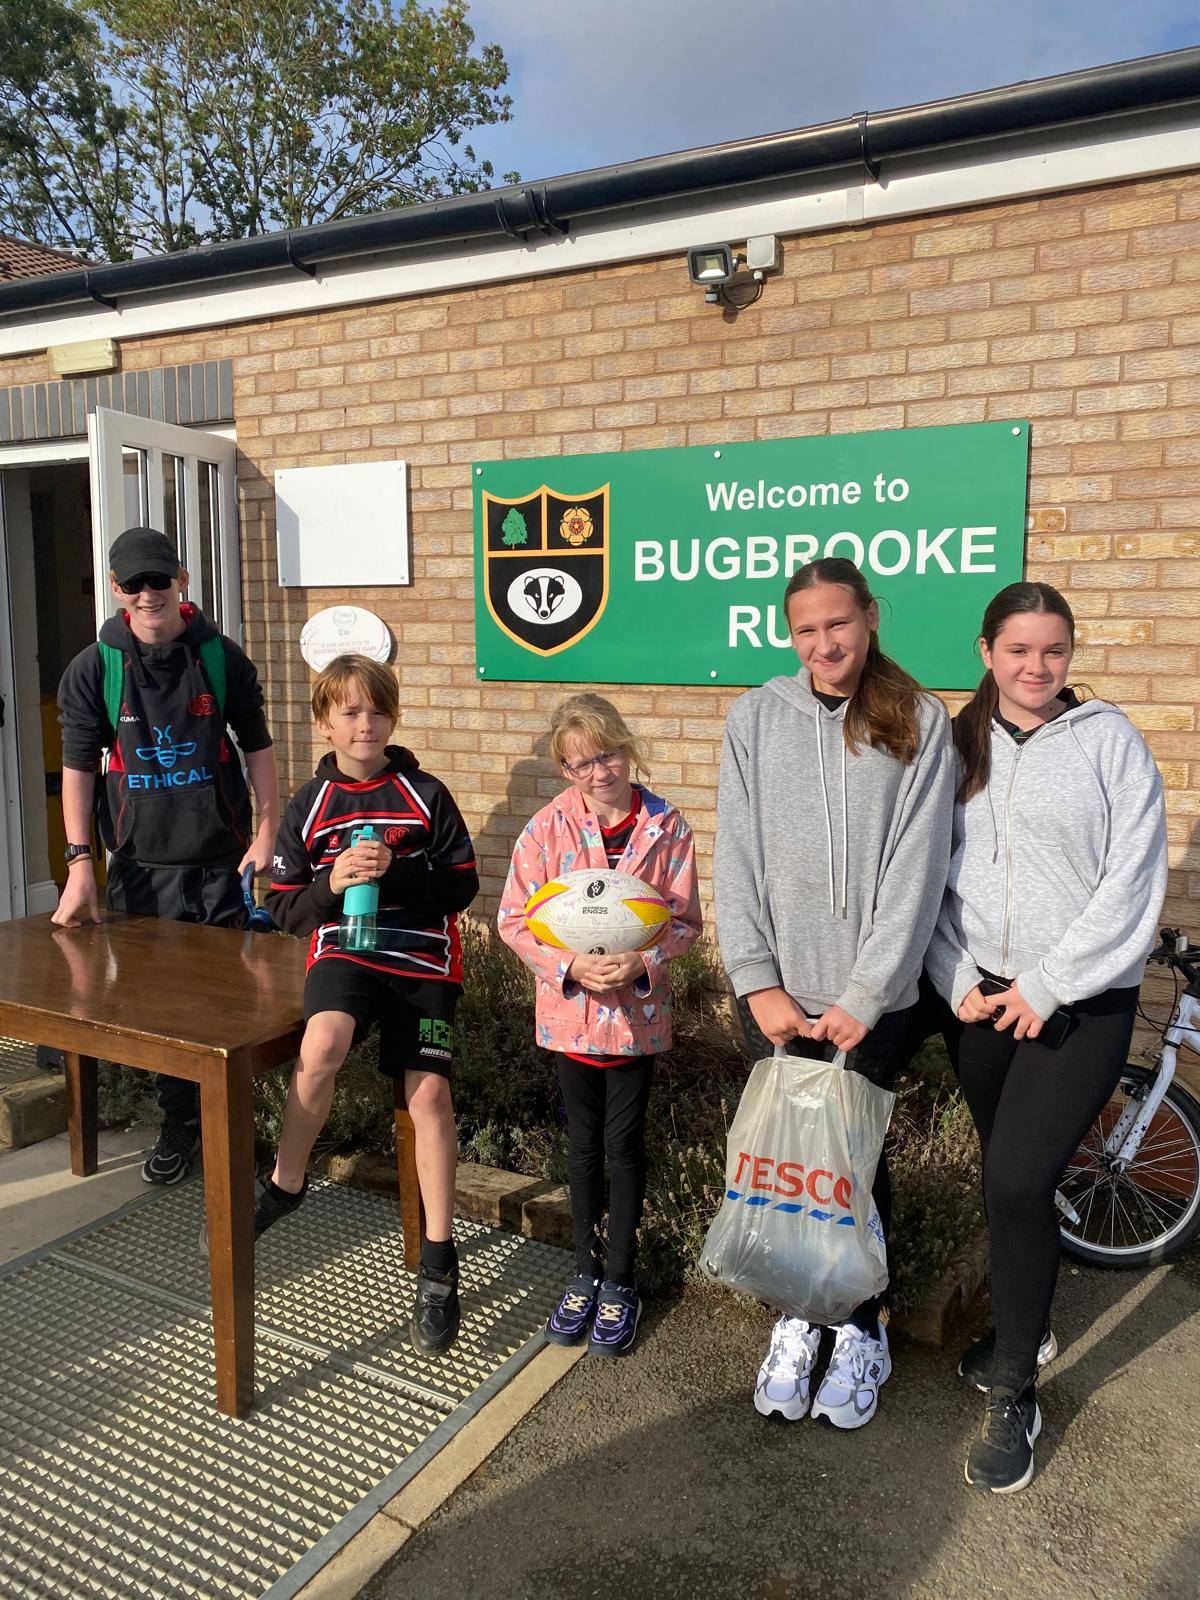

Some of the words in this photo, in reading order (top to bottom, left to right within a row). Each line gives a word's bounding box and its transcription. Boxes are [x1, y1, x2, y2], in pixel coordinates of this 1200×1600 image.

[705, 480, 862, 512] Welcome
[873, 472, 910, 503] to
[634, 526, 998, 582] BUGBROOKE
[127, 766, 213, 789] ETHICAL
[734, 1151, 852, 1210] TESCO
